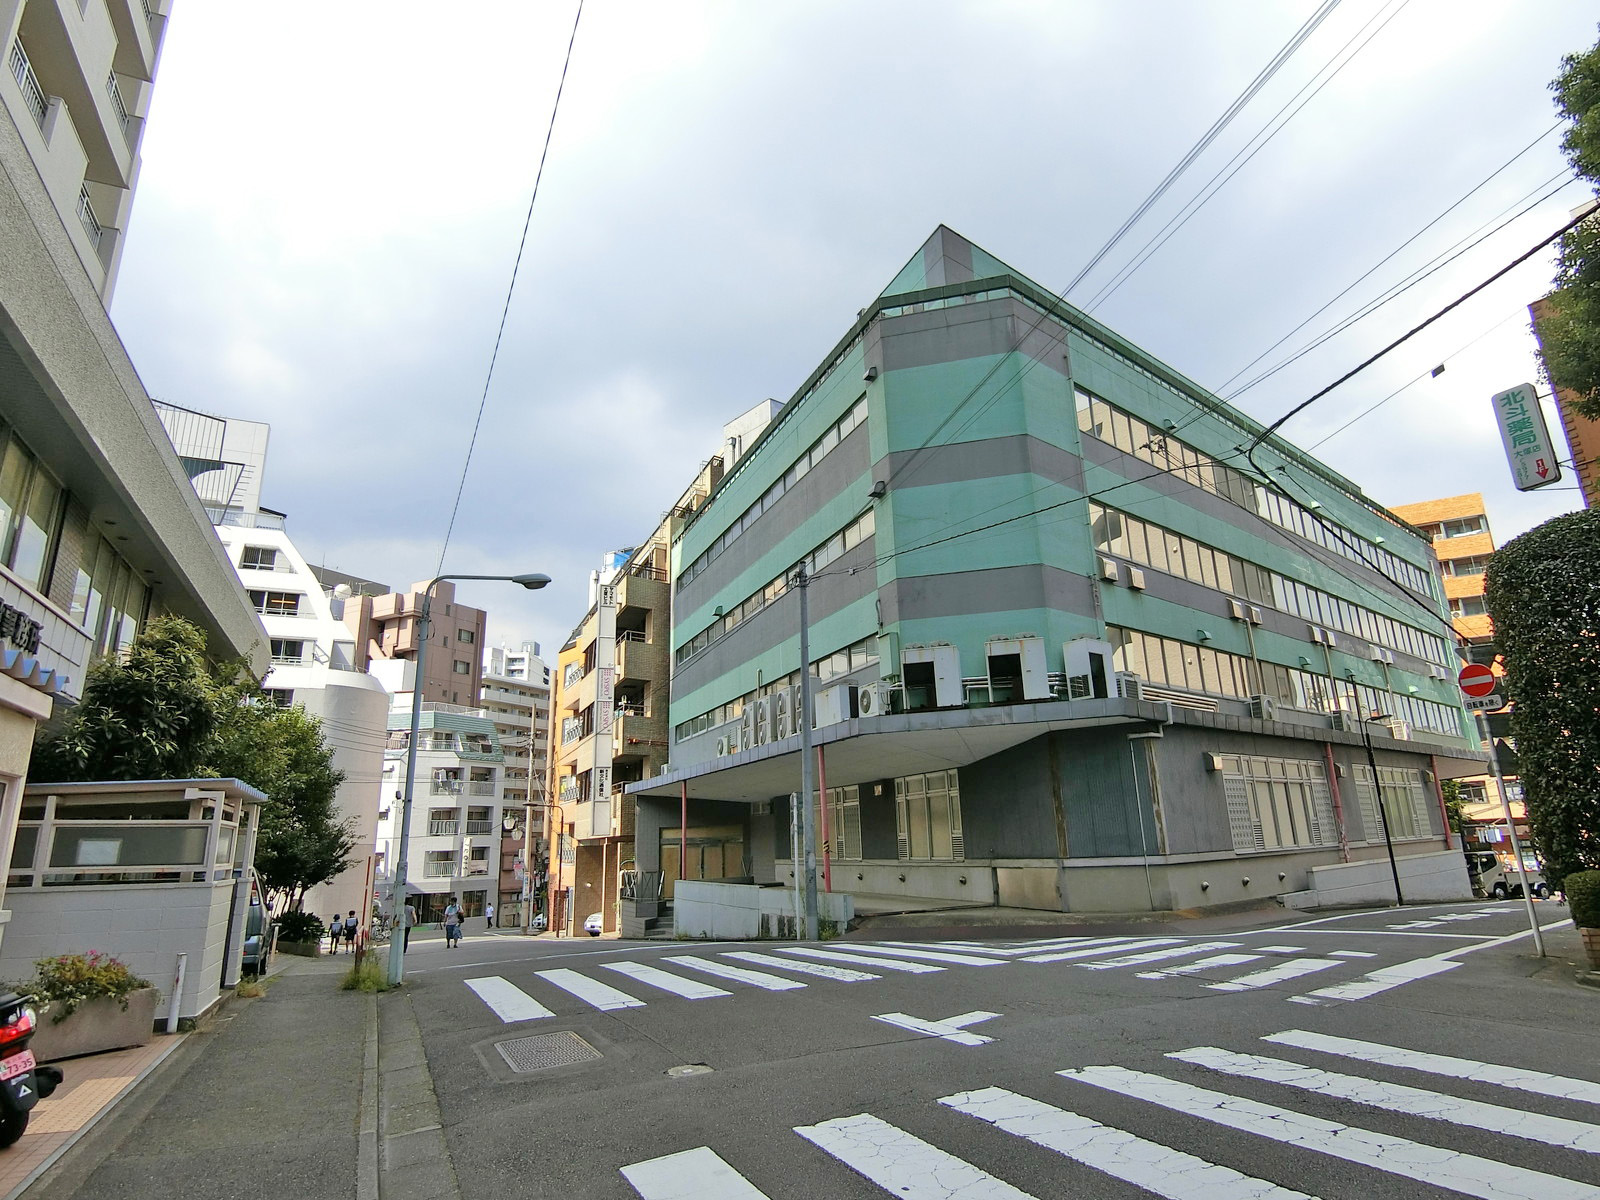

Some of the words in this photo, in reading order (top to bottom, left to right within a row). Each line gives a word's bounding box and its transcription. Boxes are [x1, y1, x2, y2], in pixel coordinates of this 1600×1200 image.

[1500, 390, 1537, 449] 北斗薬局
[1514, 444, 1541, 459] 大塚店
[0, 597, 44, 654] 事務所
[1466, 699, 1499, 709] 自転車を除く
[7, 1057, 33, 1074] 73-35
